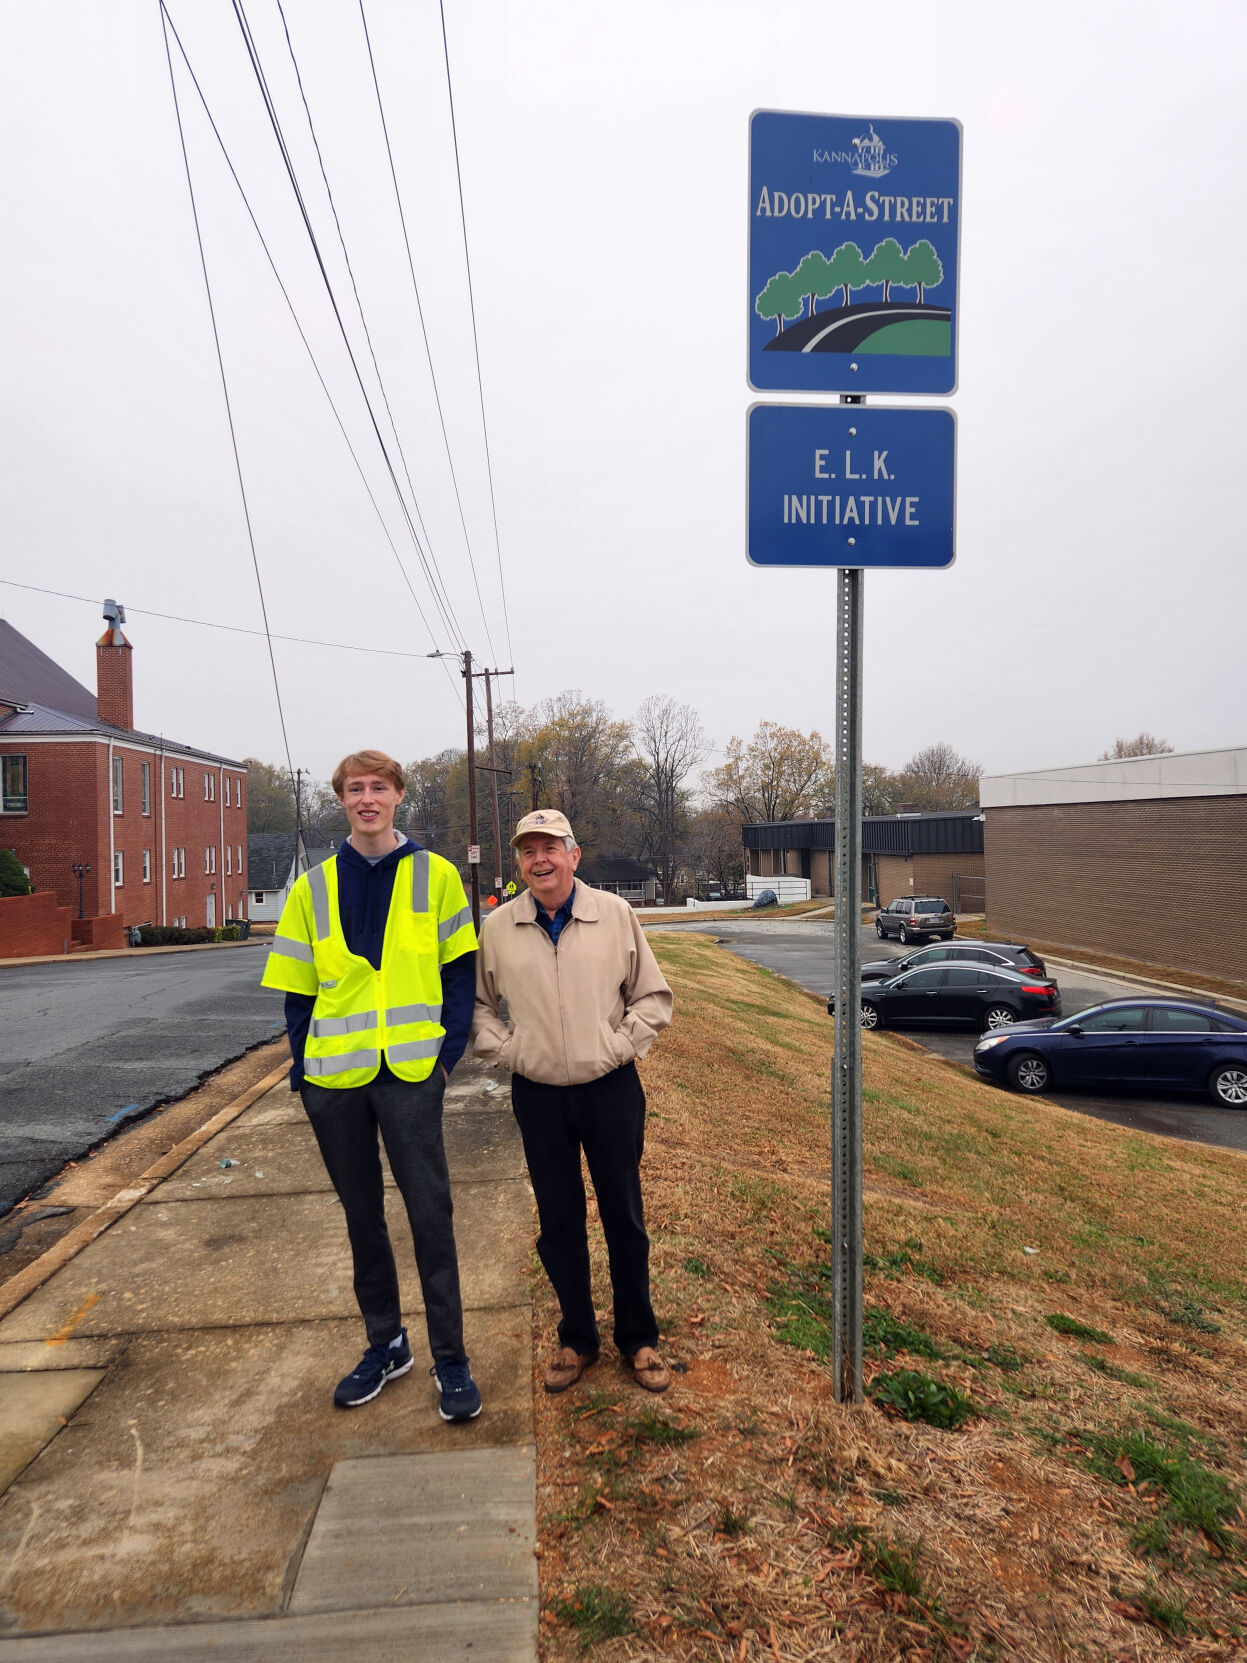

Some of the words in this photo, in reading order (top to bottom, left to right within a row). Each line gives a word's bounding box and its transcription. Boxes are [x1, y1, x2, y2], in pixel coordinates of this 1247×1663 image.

[813, 148, 898, 166] KANNAPOLIS
[756, 186, 954, 223] ADOPT-A-STREET
[783, 494, 920, 526] INITIATIVE
